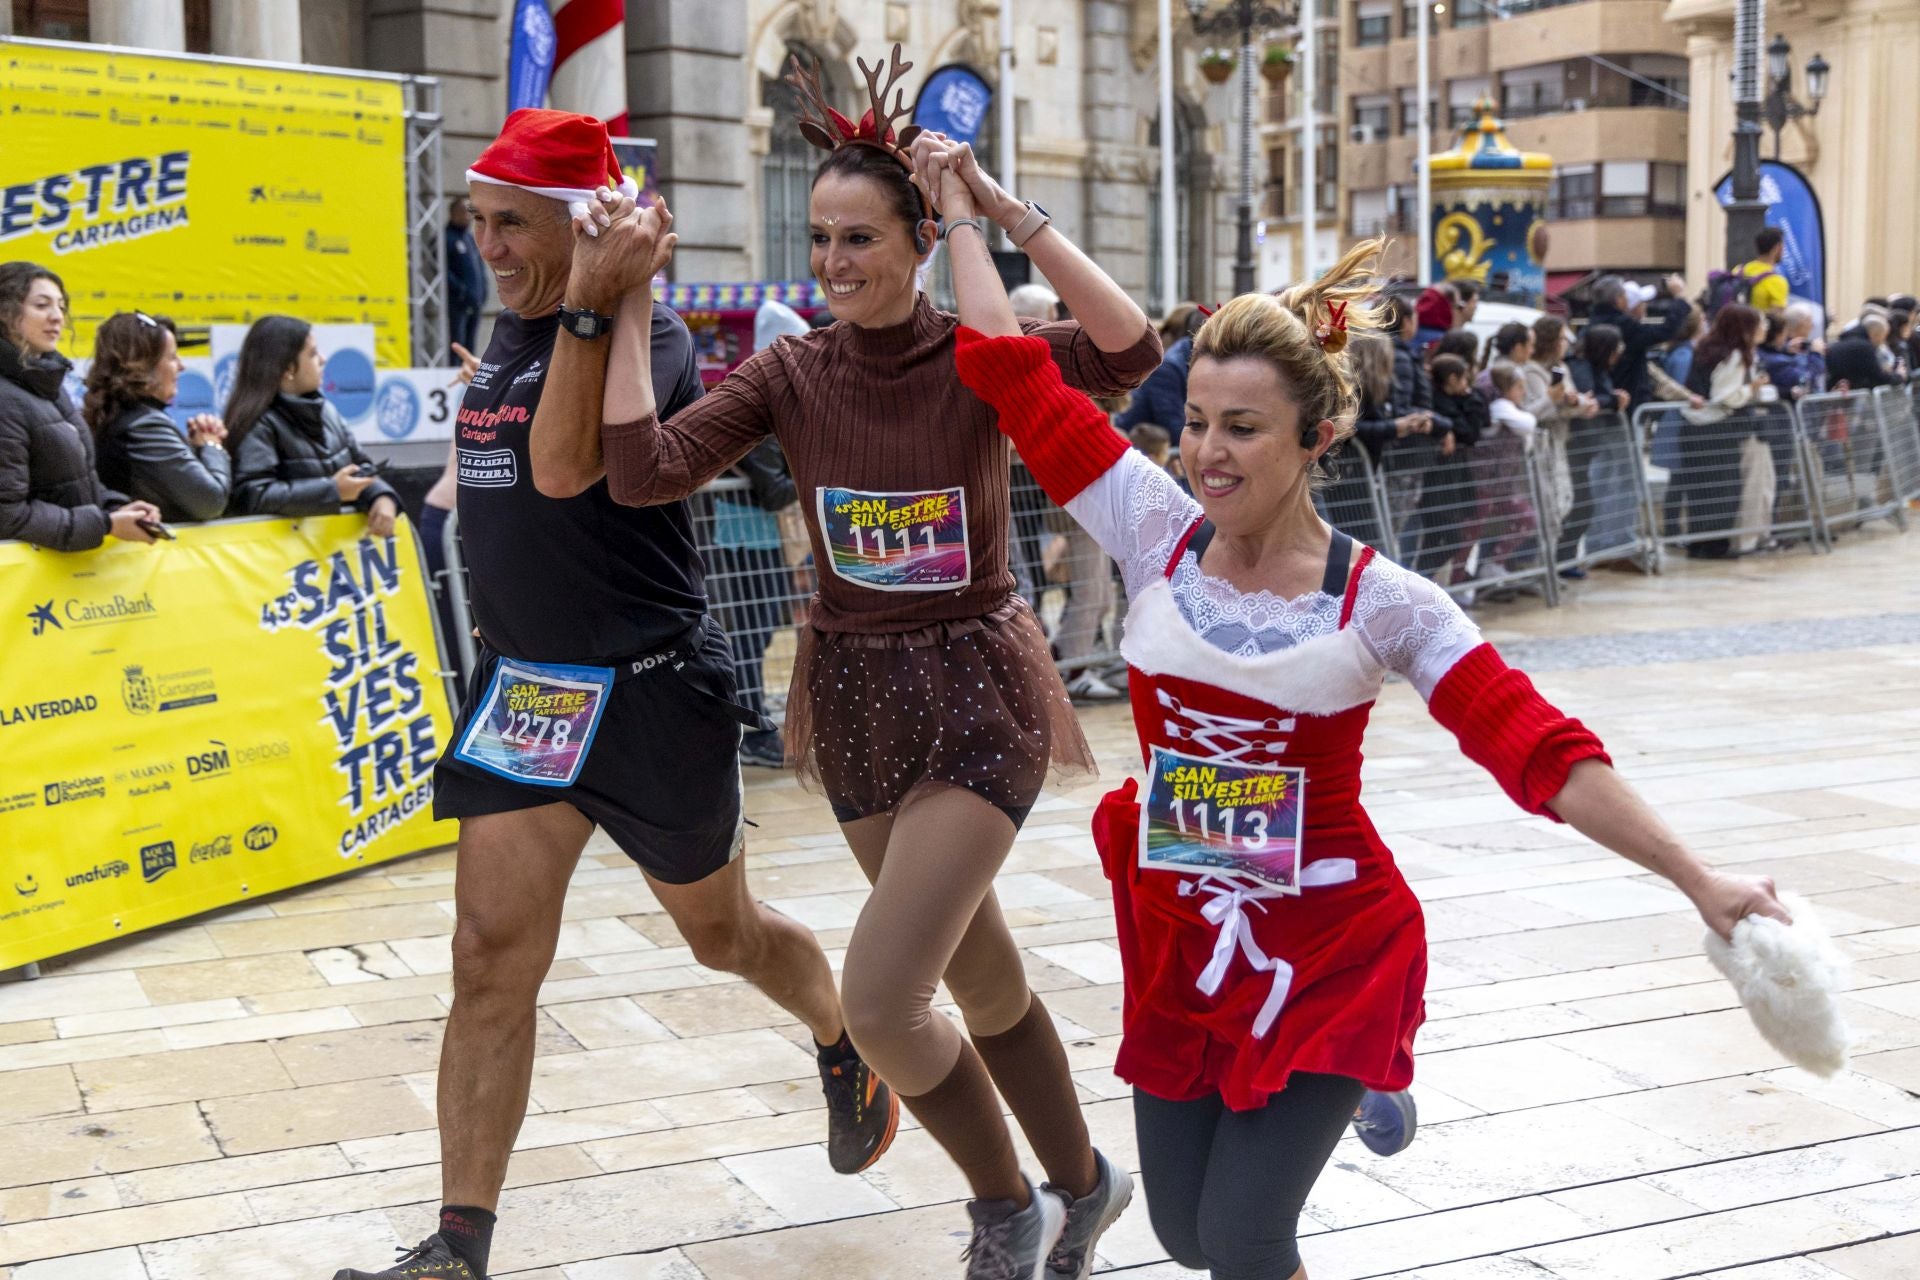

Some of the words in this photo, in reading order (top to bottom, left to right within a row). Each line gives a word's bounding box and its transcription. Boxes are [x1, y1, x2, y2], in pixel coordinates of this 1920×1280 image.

[53, 205, 189, 253] CARTAGENA
[428, 388, 450, 423] 3
[850, 494, 951, 528] SILVESTRE
[851, 498, 887, 514] SAN
[891, 508, 950, 531] CARTAGENA
[849, 525, 937, 559] 1111
[291, 536, 400, 626] SAN
[64, 592, 157, 623] CaixaBank
[323, 601, 402, 685] SIL
[323, 651, 424, 748] VES
[508, 691, 588, 711] SILVESTRE
[511, 684, 540, 698] SAN
[0, 707, 25, 726] LA
[25, 694, 98, 721] VERDAD
[534, 705, 586, 717] CARTAGENA
[500, 709, 572, 752] 2278
[186, 749, 231, 776] DSM
[337, 713, 438, 812] TRE
[1174, 766, 1217, 784] SAN
[1173, 773, 1288, 801] SILVESTRE
[1216, 792, 1286, 808] CARTAGENA
[340, 779, 433, 852] CARTAGEN
[1169, 798, 1269, 850] 1113
[142, 844, 174, 859] AQUA
[31, 899, 65, 914] Cartagena
